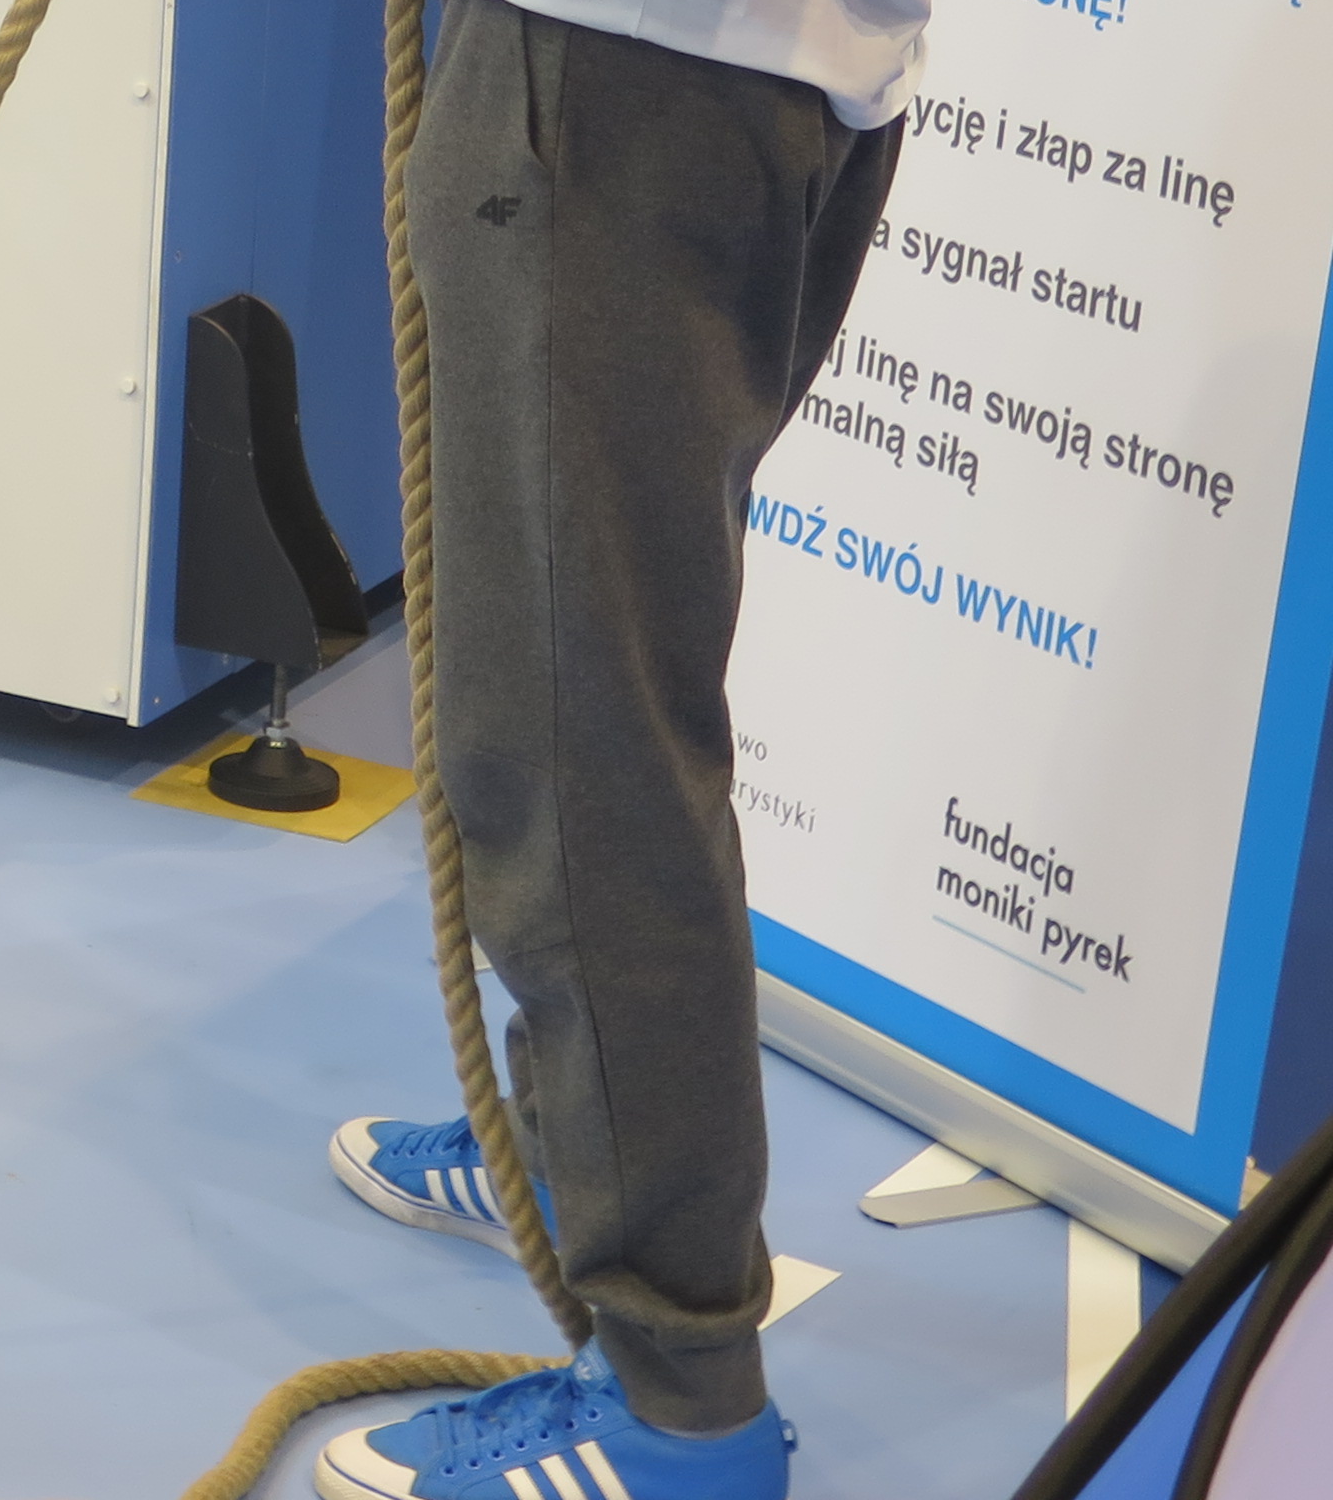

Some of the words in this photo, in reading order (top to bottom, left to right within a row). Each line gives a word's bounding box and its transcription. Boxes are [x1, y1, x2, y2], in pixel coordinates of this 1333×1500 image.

[906, 94, 985, 155] ycję
[996, 108, 1008, 151] i
[1016, 120, 1093, 184] złap
[1102, 149, 1147, 193] za
[1159, 154, 1235, 228] linę
[901, 226, 1024, 294] sygnał
[1032, 267, 1143, 333] startu
[856, 334, 919, 404] linę
[929, 369, 974, 416] na
[983, 390, 1093, 470] swoją
[1103, 430, 1235, 518] stronę
[916, 431, 980, 496] siłą
[834, 526, 945, 606] SWÓJ
[956, 572, 1099, 670] WYNIK!
[944, 796, 1076, 898] fundacja
[936, 862, 1036, 934] moniki
[1040, 916, 1134, 983] pyrek
